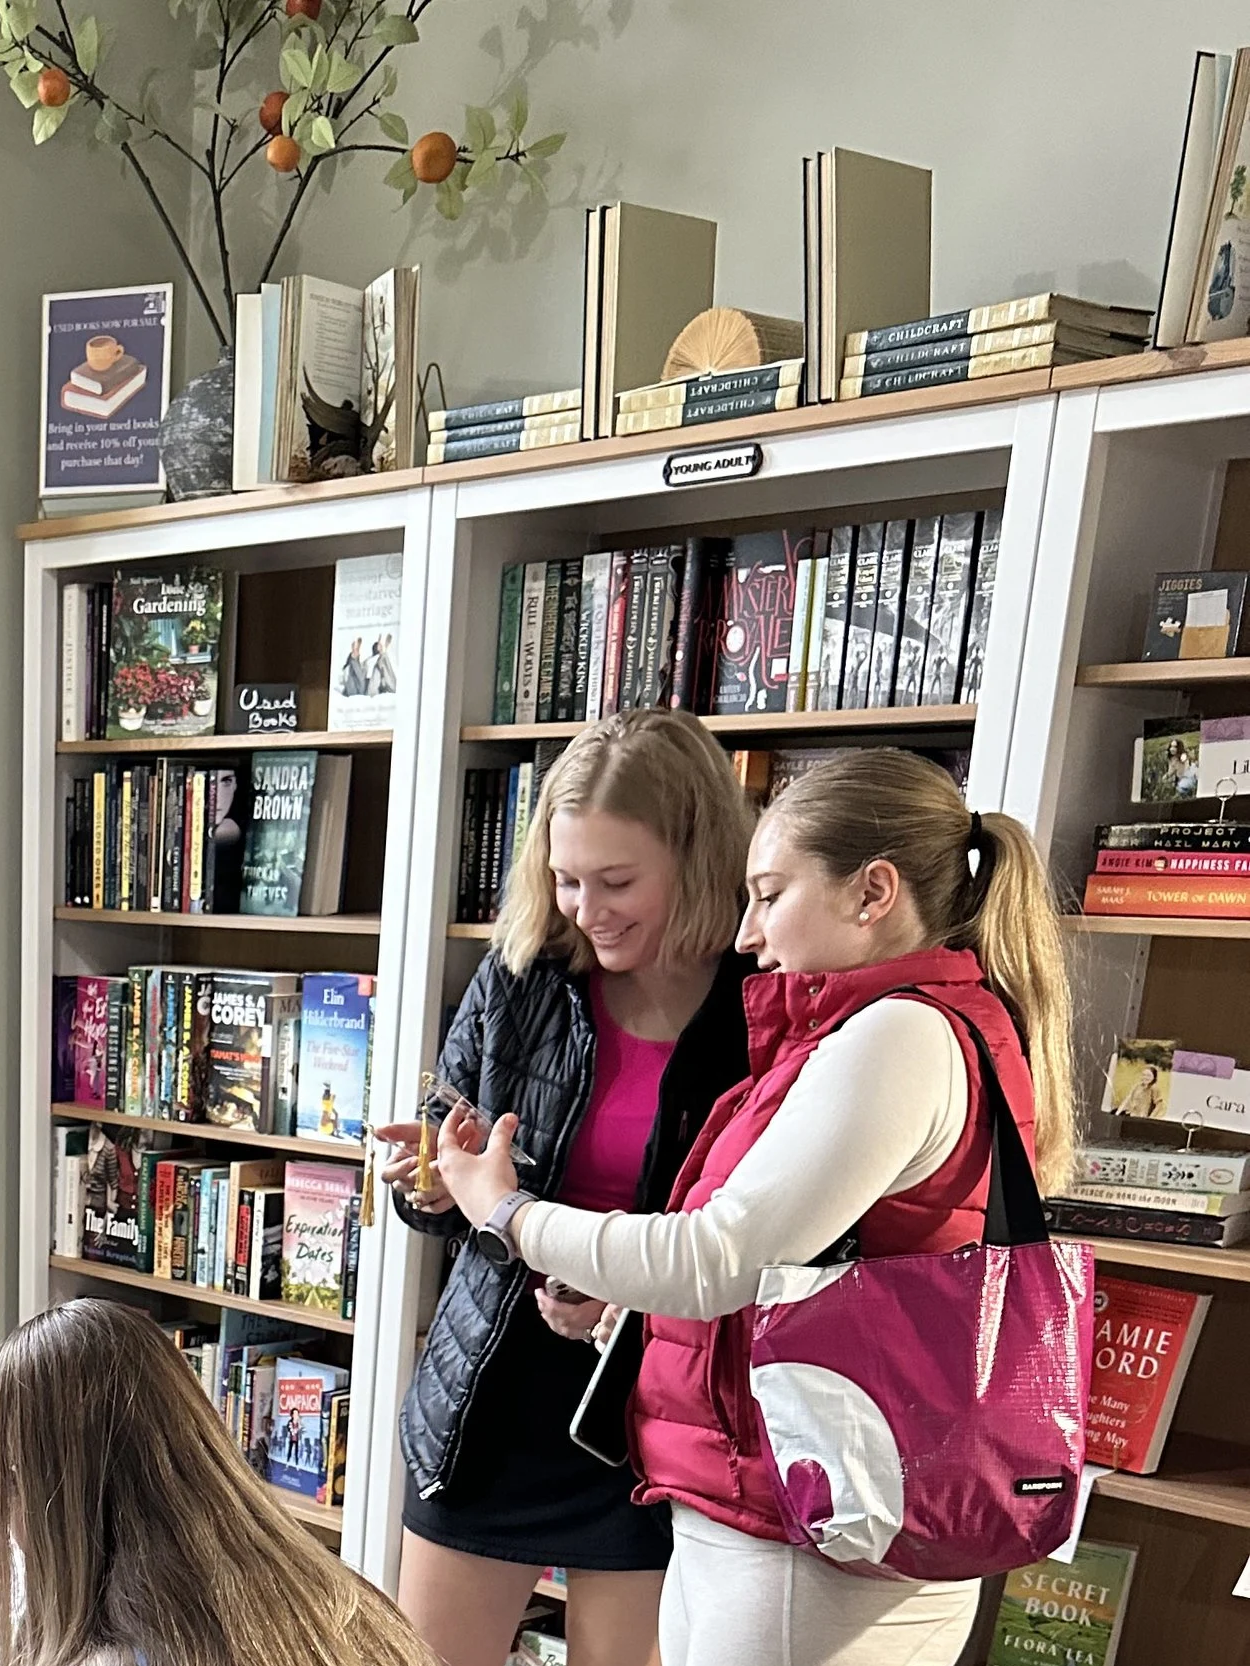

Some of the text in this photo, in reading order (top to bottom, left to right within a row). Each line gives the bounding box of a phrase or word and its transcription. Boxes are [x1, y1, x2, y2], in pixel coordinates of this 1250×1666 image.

[888, 318, 965, 344] CHILDCRAFT
[886, 341, 966, 366] CHILDCRAFT
[689, 375, 758, 397] CHILDCRAFT
[884, 363, 964, 388] CHILDCRAFT
[686, 399, 755, 420] CHILDCRAFT
[48, 418, 160, 436] Bring in your used books
[47, 439, 64, 451] and
[66, 440, 98, 450] receive
[101, 437, 120, 449] 10%
[122, 436, 138, 448] off
[60, 454, 144, 471] purchase that day!
[673, 455, 751, 476] YOUNG ADULT
[1158, 579, 1203, 592] JIGGIES
[132, 596, 206, 617] Gardening
[523, 595, 539, 687] RULE WOLVES
[575, 611, 591, 694] WICKED KING
[239, 687, 297, 712] Used
[248, 712, 297, 729] Books
[253, 765, 308, 791] SANDRA
[253, 795, 303, 820] BROWN
[481, 822, 490, 860] HUNGER
[494, 821, 502, 859] HUNGER
[1160, 827, 1237, 836] PROJECT
[1154, 840, 1192, 848] HAIL
[1201, 840, 1242, 849] MARY
[94, 857, 102, 889] ONES
[1102, 857, 1131, 868] ANGIE
[1135, 857, 1153, 867] KIM
[1170, 858, 1231, 871] HAPPINESS
[247, 886, 288, 901] THIEVES
[1102, 896, 1125, 904] MAAS
[1146, 891, 1188, 903] TOWER
[1208, 892, 1247, 904] DAWN
[132, 982, 142, 1026] JAMES
[183, 984, 193, 1030] JAMES
[212, 992, 244, 1006] JAMES
[322, 987, 345, 1006] Elin
[211, 1004, 266, 1028] COREY
[303, 1008, 366, 1030] Hilderbrand
[107, 1001, 120, 1097] THE MISSING ONE
[130, 1057, 140, 1100] COREY
[180, 1061, 190, 1107] COREY
[1205, 1094, 1247, 1115] Cara
[139, 1156, 149, 1231] CRAZY RICH ASIANS
[1153, 1195, 1178, 1206] MOON
[85, 1208, 139, 1246] The Family
[285, 1214, 344, 1238] Expiration
[296, 1242, 334, 1263] Dates
[1095, 1319, 1173, 1356] AMIE
[1095, 1347, 1160, 1380] ORD
[1100, 1394, 1131, 1415] Many
[1086, 1411, 1126, 1429] ughters
[1084, 1427, 1101, 1443] ong
[1021, 1571, 1111, 1606] SECRET
[1024, 1596, 1094, 1627] BOOK
[1003, 1634, 1057, 1657] FLORA
[1065, 1647, 1095, 1666] LEA
